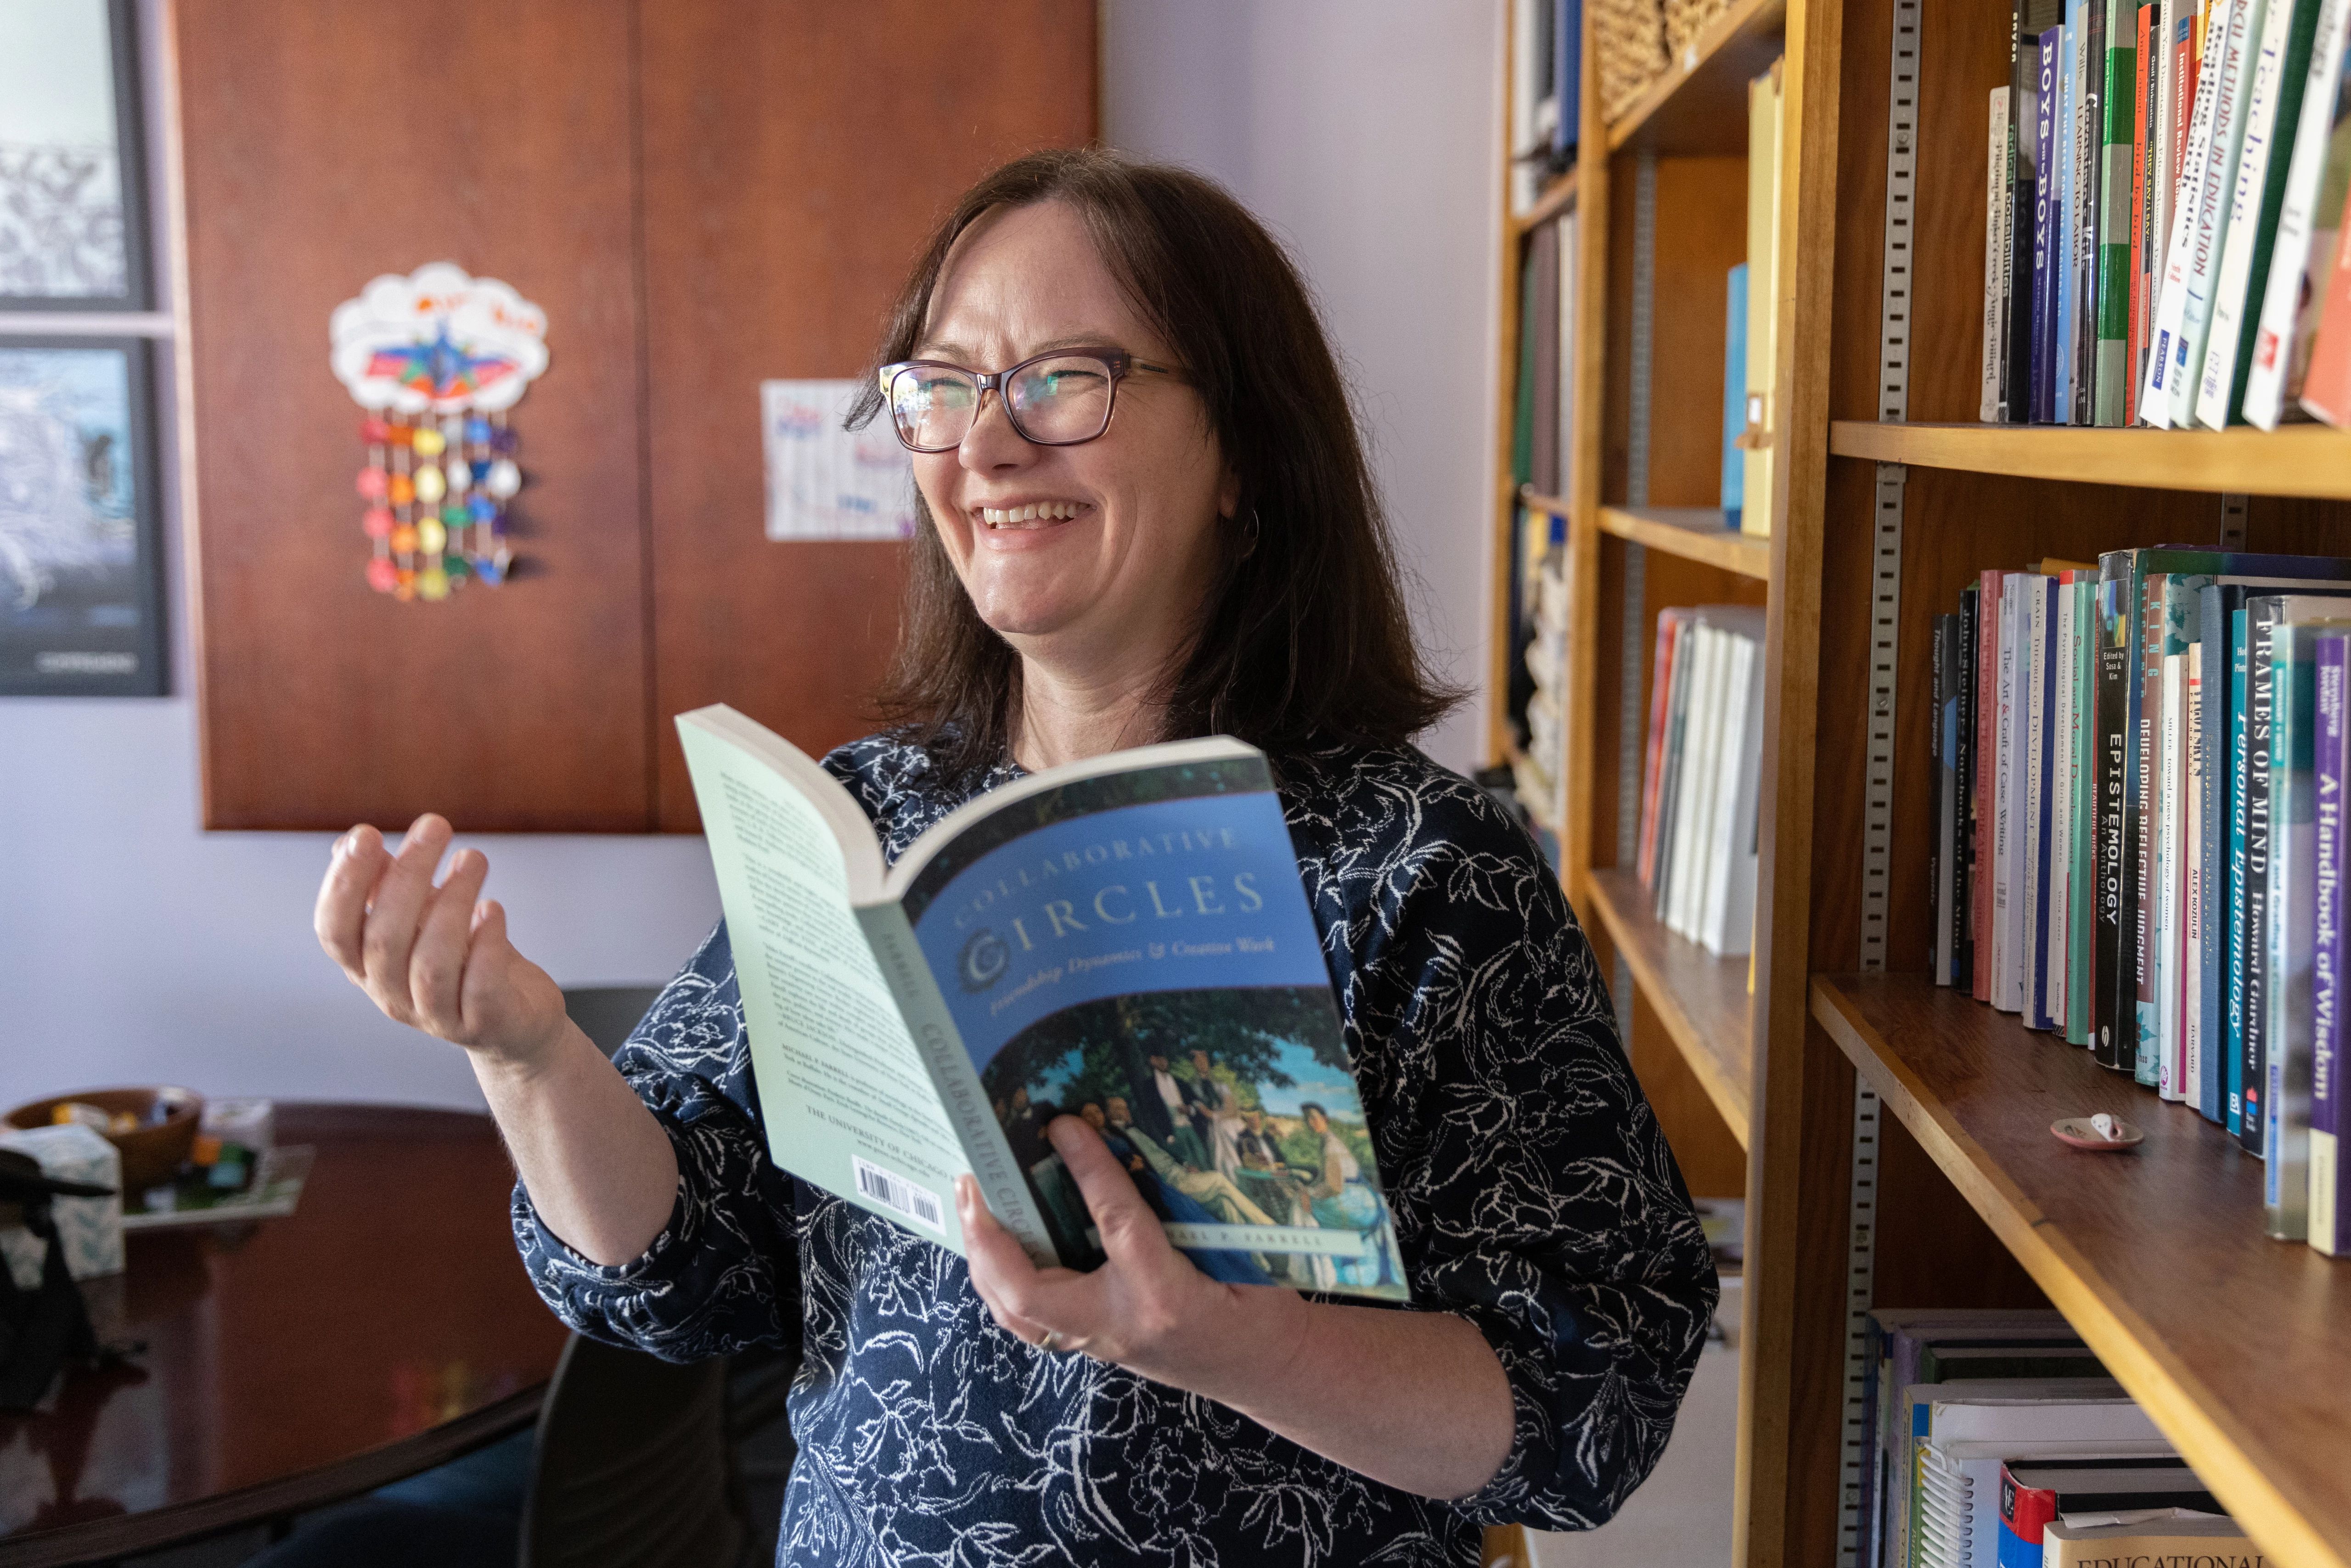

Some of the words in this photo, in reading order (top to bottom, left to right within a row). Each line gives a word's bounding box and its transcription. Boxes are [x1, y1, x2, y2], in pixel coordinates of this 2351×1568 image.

[2040, 42, 2053, 140] BOYS
[2177, 52, 2185, 131] Institutional
[2199, 26, 2223, 127] Reading
[2217, 46, 2240, 137] METHODS
[2006, 124, 2014, 185] radical
[2075, 106, 2084, 184] LEARNING
[2176, 133, 2184, 174] Review
[2181, 79, 2206, 188] Research
[2210, 145, 2225, 166] IN
[2036, 173, 2047, 270] BOYS
[2074, 191, 2080, 206] TO
[2134, 186, 2140, 205] by
[2182, 136, 2206, 248] Statistics
[2194, 172, 2221, 277] EDUCATION
[2002, 192, 2012, 298] possibilities
[2155, 337, 2167, 383] PEARSON
[2072, 635, 2081, 682] Social
[2148, 601, 2160, 676] KING
[2002, 703, 2009, 715] &
[2032, 696, 2038, 709] OF
[2254, 620, 2273, 741] FRAMES
[2001, 718, 2009, 748] Craft
[2001, 753, 2008, 768] of
[2071, 712, 2080, 758] Moral
[2139, 719, 2151, 809] DEVELOPING
[2252, 750, 2269, 788] OF
[2029, 715, 2039, 832] DEVELOPMENT
[2060, 768, 2064, 778] of
[2235, 712, 2248, 836] Personal
[2319, 773, 2339, 795] A
[1998, 809, 2007, 856] Writing
[2069, 764, 2079, 864] Development
[2100, 815, 2108, 836] An
[2107, 734, 2121, 925] EPISTEMOLOGY
[2250, 796, 2269, 873] MIND
[954, 827, 1235, 928] COLLABORATIVE
[2099, 843, 2107, 923] Anthology
[2165, 882, 2171, 893] of
[2317, 803, 2339, 944] Handbook
[967, 872, 1263, 982] CIRCLES
[2229, 849, 2246, 1038] Epistemology
[2250, 892, 2264, 975] Howard
[2316, 951, 2335, 987] of
[782, 1042, 812, 1062] MICHAEL
[2248, 978, 2261, 1070] Gardner
[2314, 988, 2335, 1100] Wisdom
[920, 1022, 1003, 1181] COLLABORATIVE
[806, 1104, 826, 1120] THE
[828, 1113, 886, 1147] UNIVERSITY
[887, 1141, 902, 1155] OF
[902, 1148, 949, 1179] CHICAGO
